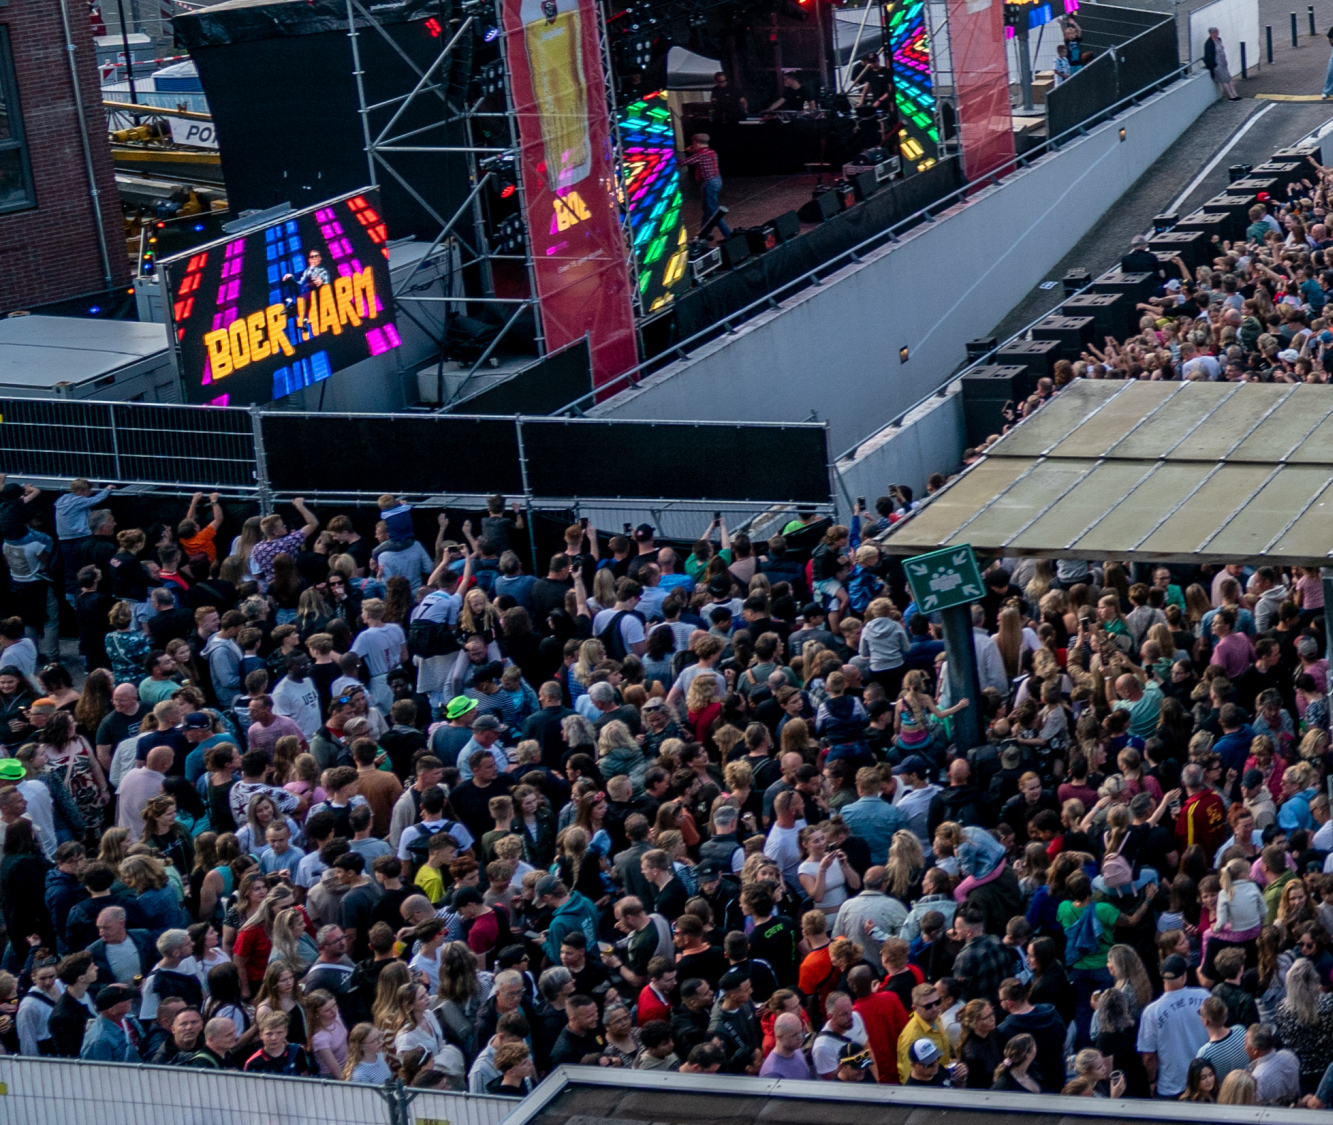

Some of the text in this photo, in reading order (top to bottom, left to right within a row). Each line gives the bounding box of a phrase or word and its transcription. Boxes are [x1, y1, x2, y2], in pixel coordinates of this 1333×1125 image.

[203, 266, 378, 380] BOER HARM
[423, 603, 434, 619] 7
[764, 923, 784, 939] CREW
